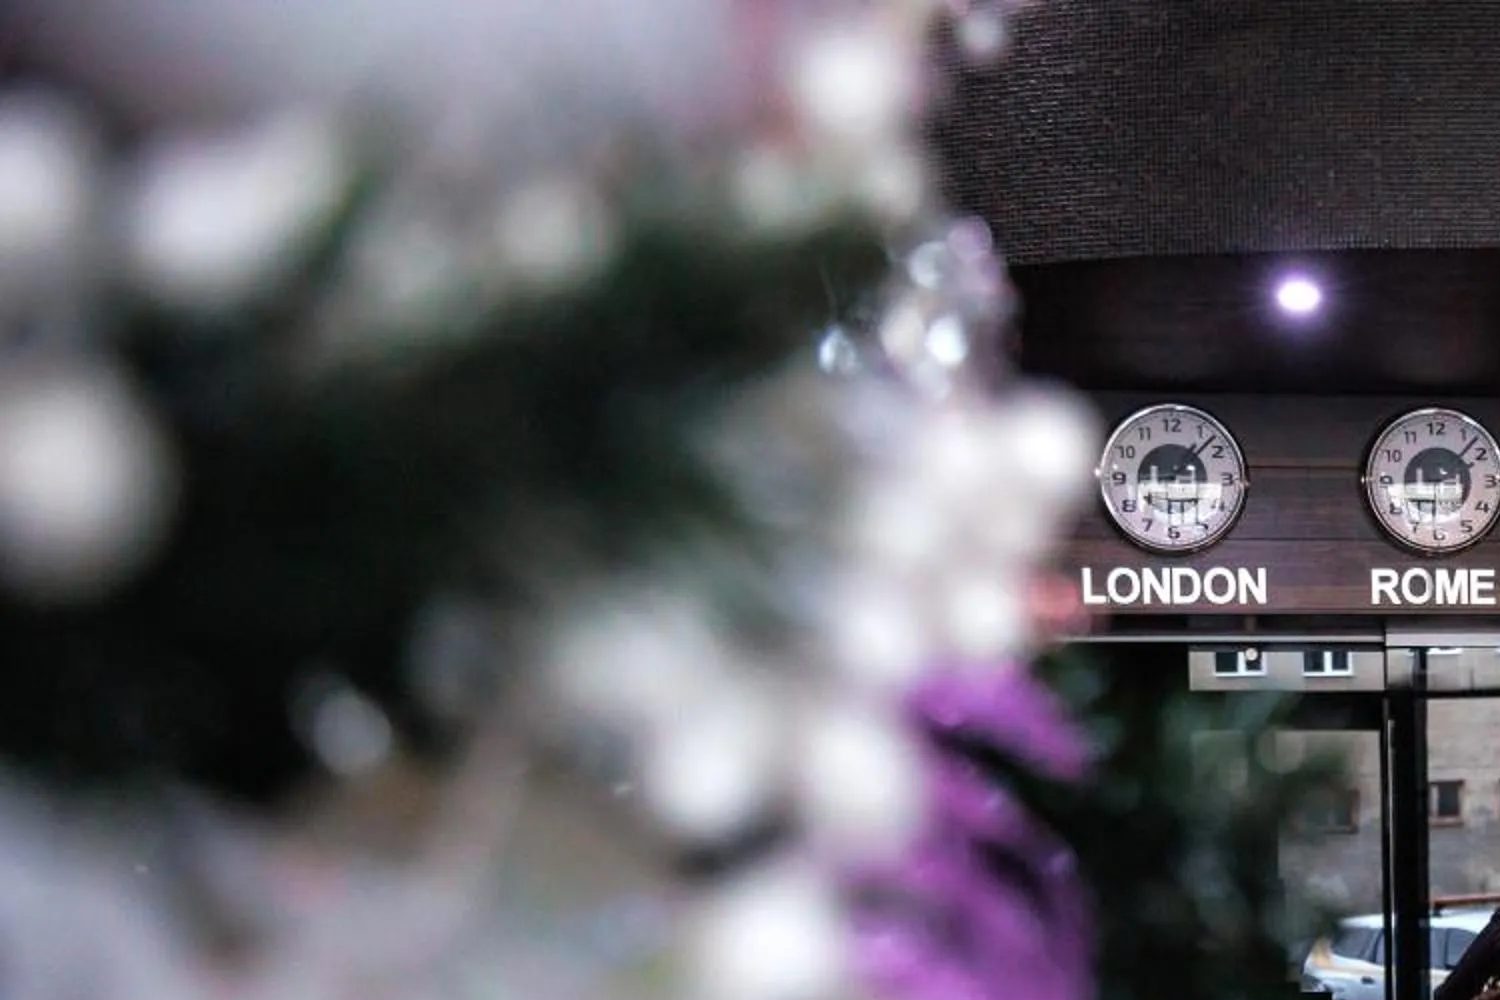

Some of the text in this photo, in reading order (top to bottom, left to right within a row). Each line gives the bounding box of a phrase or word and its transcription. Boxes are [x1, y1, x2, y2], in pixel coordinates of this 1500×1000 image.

[1162, 419, 1182, 433] 12
[1427, 422, 1446, 436] 12
[1138, 427, 1151, 441] 11
[1403, 431, 1417, 445] 11
[1117, 445, 1136, 459] 10
[1212, 445, 1225, 459] 2
[1384, 449, 1402, 463] 10
[1475, 447, 1488, 461] 2
[1221, 472, 1234, 486] 3
[1484, 474, 1498, 488] 3
[1122, 499, 1137, 513] 8
[1475, 500, 1490, 513] 4
[1142, 518, 1153, 532] 7
[1460, 519, 1473, 533] 5
[1083, 567, 1266, 604] LONDON
[1372, 568, 1496, 604] ROME
